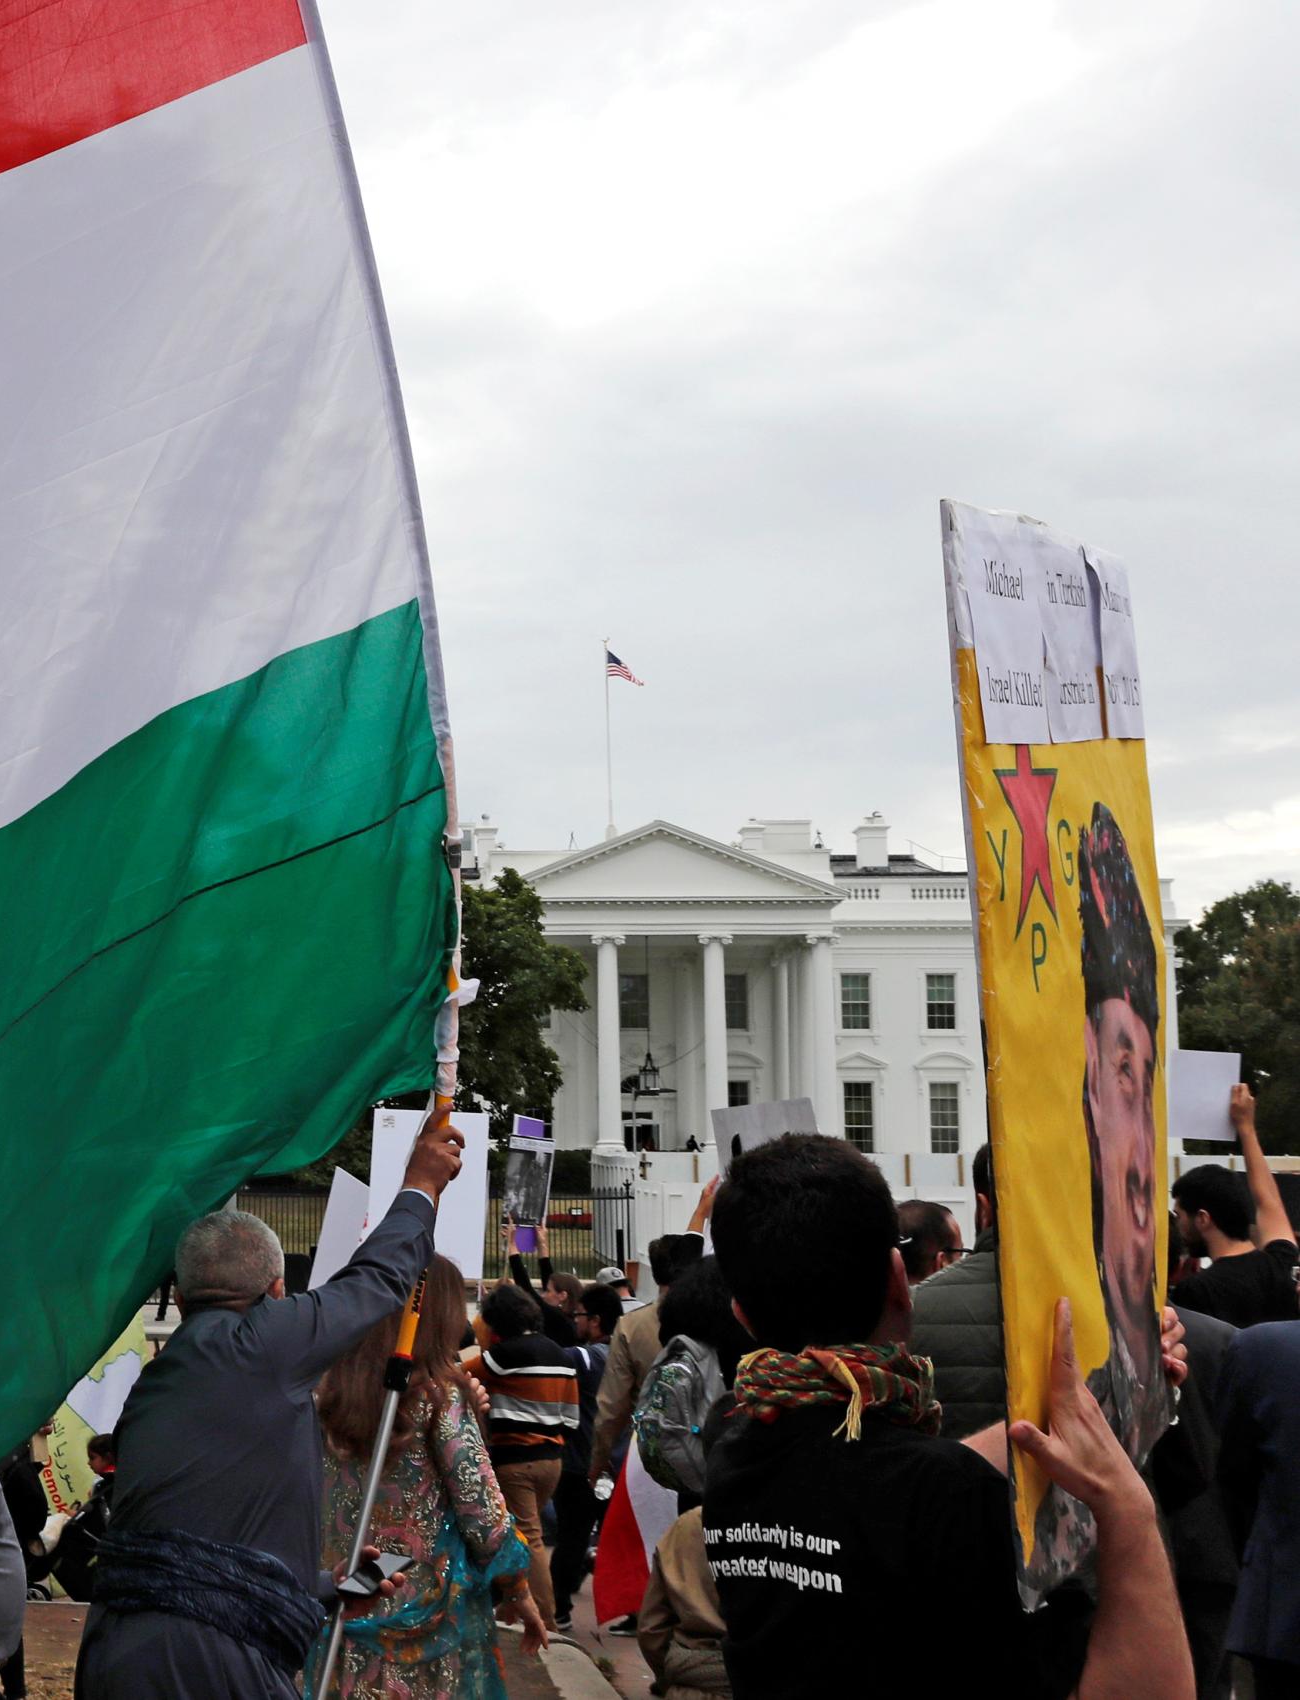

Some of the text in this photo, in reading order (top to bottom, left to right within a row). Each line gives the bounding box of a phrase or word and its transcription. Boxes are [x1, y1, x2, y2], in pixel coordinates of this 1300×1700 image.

[983, 559, 1025, 601] Michael
[1046, 570, 1087, 608] in Turkish
[986, 666, 1043, 707] Israel Killed
[986, 819, 1074, 902] Y G
[1032, 923, 1047, 993] P
[790, 1525, 804, 1548] is
[805, 1534, 841, 1555] our
